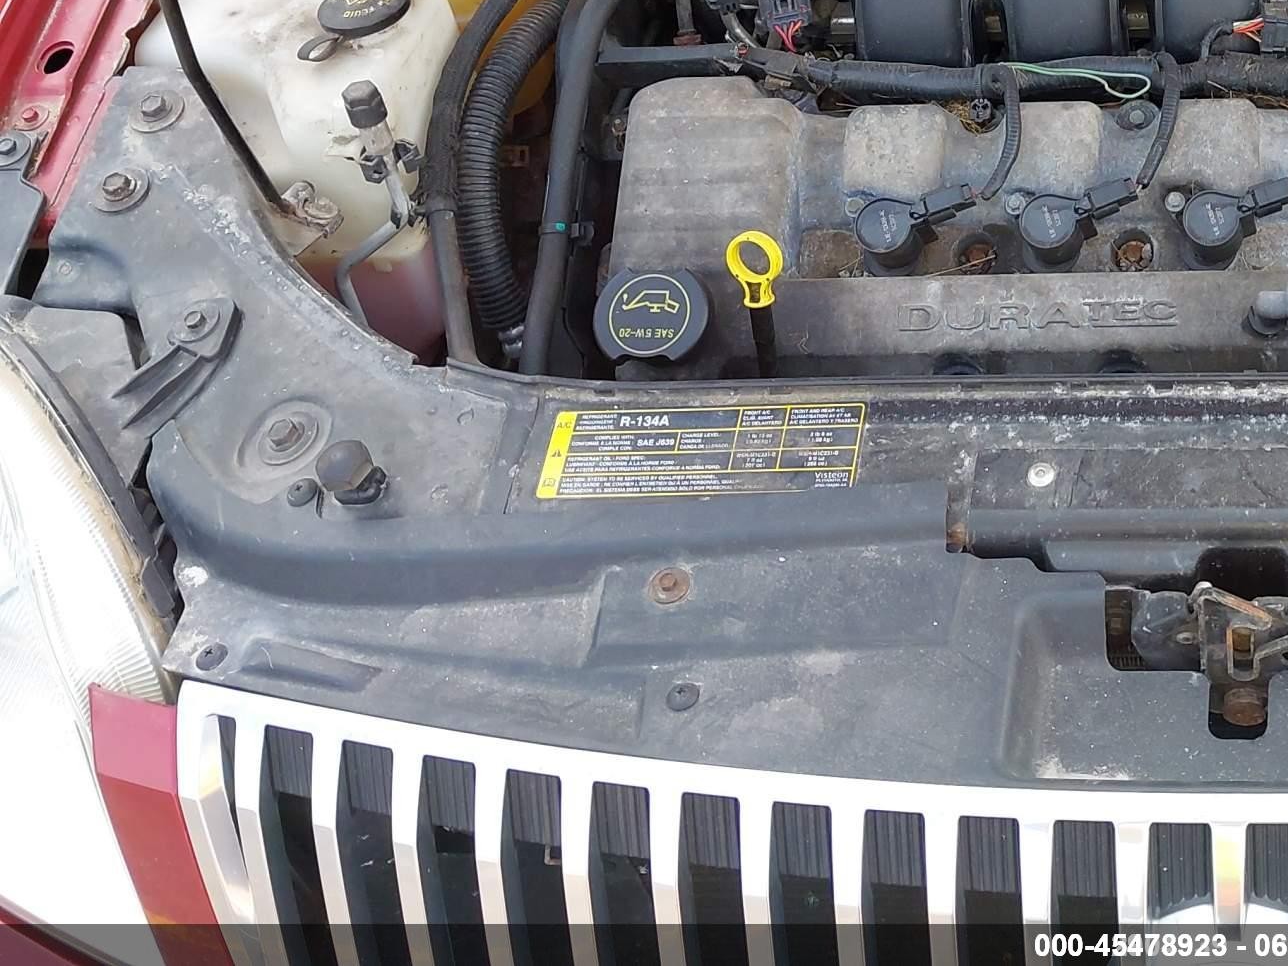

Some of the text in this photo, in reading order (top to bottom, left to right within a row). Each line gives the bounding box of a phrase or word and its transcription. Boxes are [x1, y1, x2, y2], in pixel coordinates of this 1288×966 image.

[899, 299, 1178, 331] DURATEC
[619, 328, 675, 338] SAE 5W-20
[620, 414, 670, 427] R-134A
[637, 438, 676, 446] SAE J639
